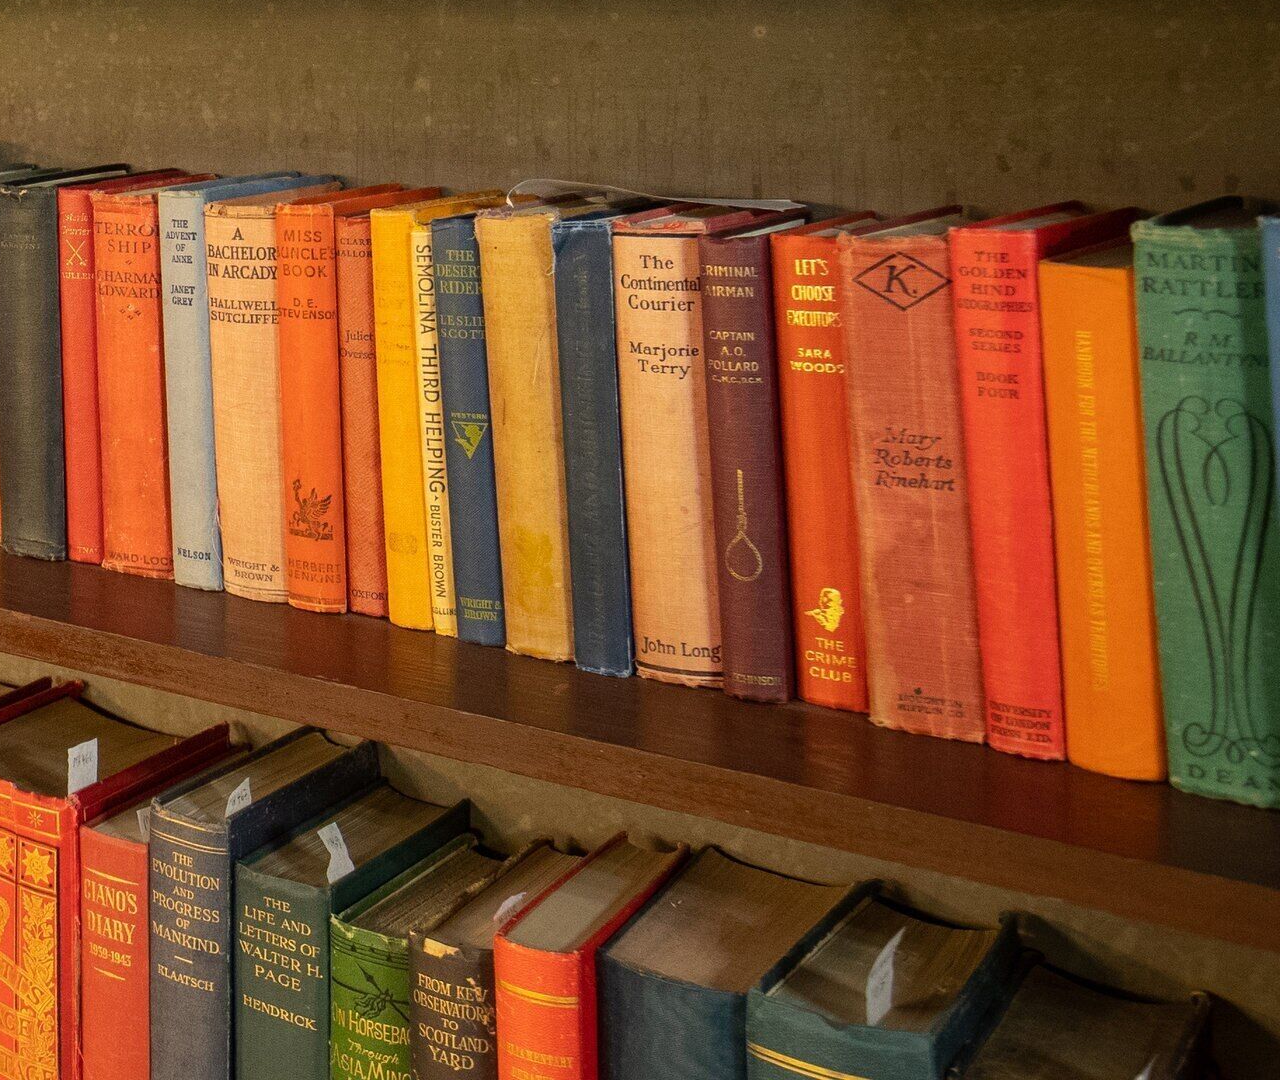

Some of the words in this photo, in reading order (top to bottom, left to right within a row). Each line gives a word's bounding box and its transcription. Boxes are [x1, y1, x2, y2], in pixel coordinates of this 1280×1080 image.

[165, 230, 198, 242] ADVENT
[231, 227, 245, 241] A
[283, 229, 322, 243] MISS
[207, 245, 278, 262] BACHELOR
[445, 248, 475, 262] THE
[973, 250, 1011, 264] THE
[282, 263, 329, 278] BOOK
[639, 254, 674, 271] The
[794, 258, 829, 277] LET'S
[957, 265, 1029, 282] GOLDEN
[415, 243, 435, 336] SEMOLINA
[620, 273, 701, 293] Continental
[970, 282, 1017, 298] HIND
[171, 296, 194, 307] GREY
[791, 285, 837, 302] CHOOSE
[627, 294, 696, 313] Courier
[210, 311, 280, 325] SUTCLIFFE
[708, 329, 756, 342] CAPTAIN
[968, 327, 1025, 341] SECOND
[629, 340, 700, 362] Marjorie
[796, 347, 833, 359] SARA
[970, 340, 1023, 354] SERIES
[420, 343, 440, 404] THIRD
[637, 358, 692, 380] Terry
[789, 360, 845, 374] WOODS
[975, 371, 1020, 386] BOOK
[976, 385, 1021, 400] FOUR
[880, 425, 943, 451] Mary
[425, 411, 445, 495] HELPING
[874, 448, 954, 471] Roberts
[233, 569, 274, 583] BROWN
[640, 635, 677, 657] John
[681, 641, 722, 664] Long
[814, 636, 845, 652] THE
[804, 650, 858, 669] CRIME
[808, 666, 854, 683] CLUB
[171, 850, 194, 868] THE
[151, 856, 221, 892] EVOLUTION
[172, 885, 195, 901] AND
[152, 888, 221, 925] PROGRESS
[262, 895, 292, 914] THE
[86, 909, 137, 945] DIARY
[175, 916, 191, 930] OF
[244, 903, 276, 926] LIFE
[280, 916, 312, 937] AND
[151, 919, 221, 956] MANKIND
[238, 920, 296, 953] LETTERS
[299, 943, 321, 959] OF
[239, 938, 302, 973] WALTER
[306, 963, 325, 980] H.
[157, 963, 215, 993] KLAATSCH
[254, 963, 302, 993] PAGE
[242, 993, 318, 1032] HENDRICK
[442, 1016, 459, 1032] TO
[418, 1022, 490, 1054] SCOTLAND
[427, 1044, 475, 1071] YARD
